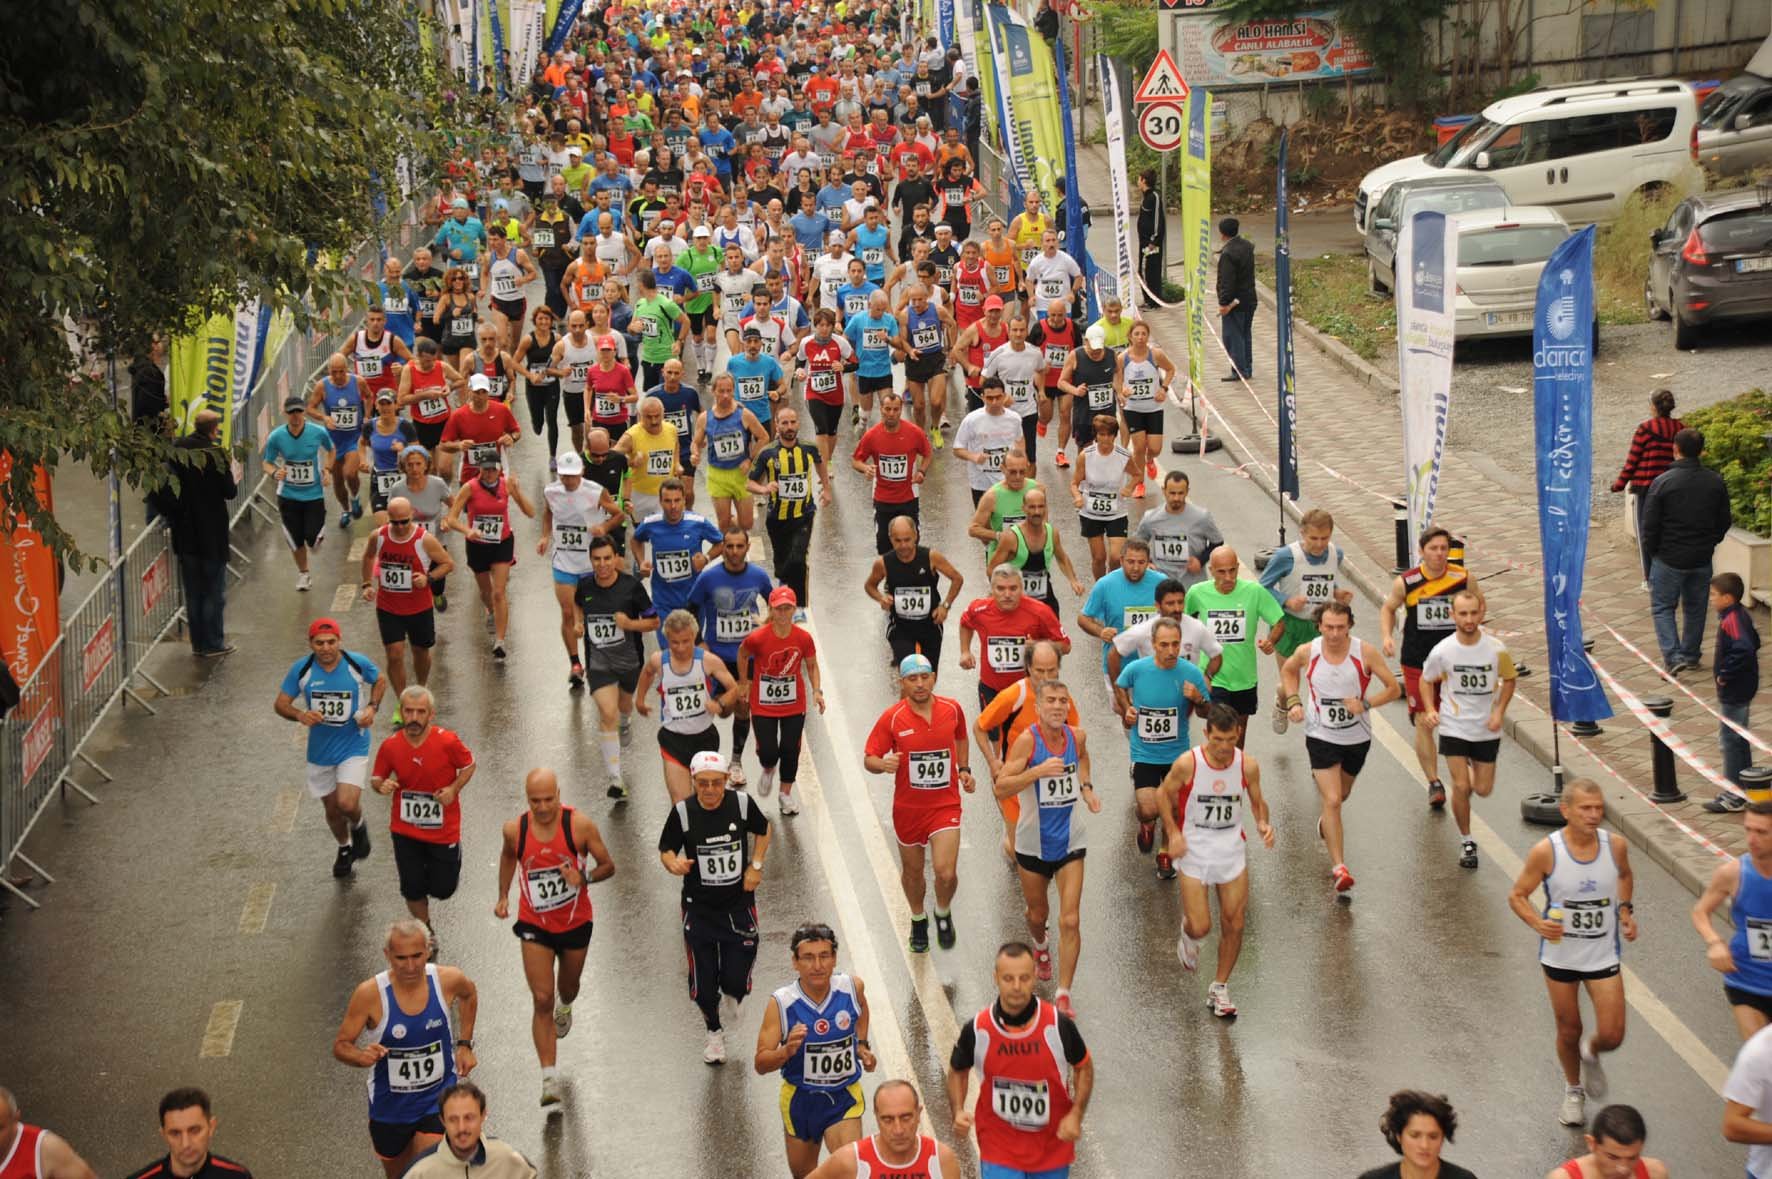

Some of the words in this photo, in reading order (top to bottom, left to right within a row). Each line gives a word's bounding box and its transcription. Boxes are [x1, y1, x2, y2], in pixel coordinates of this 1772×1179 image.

[1237, 26, 1260, 39] ALO
[1264, 20, 1307, 37] HAMSİ
[1234, 41, 1263, 51] CANLI
[1265, 38, 1313, 49] ALABALIK
[1149, 117, 1180, 135] 30
[866, 253, 880, 262] 697
[1045, 285, 1060, 295] 465
[849, 302, 864, 311] 972
[919, 334, 934, 344] 964
[1049, 352, 1064, 362] 442
[743, 382, 761, 394] 862
[1010, 386, 1026, 397] 140
[1133, 386, 1150, 396] 252
[336, 414, 353, 424] 765
[720, 439, 739, 454] 575
[291, 468, 309, 480] 312
[881, 461, 906, 475] 1137
[784, 481, 804, 494] 748
[1092, 499, 1112, 512] 655
[477, 521, 499, 535] 434
[561, 531, 583, 546] 534
[1161, 543, 1182, 556] 149
[658, 558, 689, 575] 1139
[384, 570, 405, 585] 601
[1306, 582, 1329, 597] 886
[901, 597, 925, 611] 394
[1425, 606, 1450, 621] 848
[594, 623, 617, 639] 827
[719, 619, 750, 633] 1132
[1214, 619, 1239, 635] 226
[994, 646, 1020, 662] 315
[1460, 674, 1487, 688] 803
[766, 684, 790, 698] 665
[318, 700, 345, 717] 338
[675, 695, 701, 712] 826
[1144, 718, 1171, 733] 568
[917, 761, 945, 779] 949
[1047, 776, 1073, 796] 913
[405, 802, 441, 818] 1024
[1204, 805, 1233, 821] 718
[707, 854, 737, 875] 816
[537, 877, 569, 900] 322
[1571, 910, 1604, 930] 830
[997, 1039, 1041, 1057] AKUT
[399, 1057, 434, 1080] 419
[808, 1051, 852, 1074] 1068
[997, 1093, 1047, 1116] 1090
